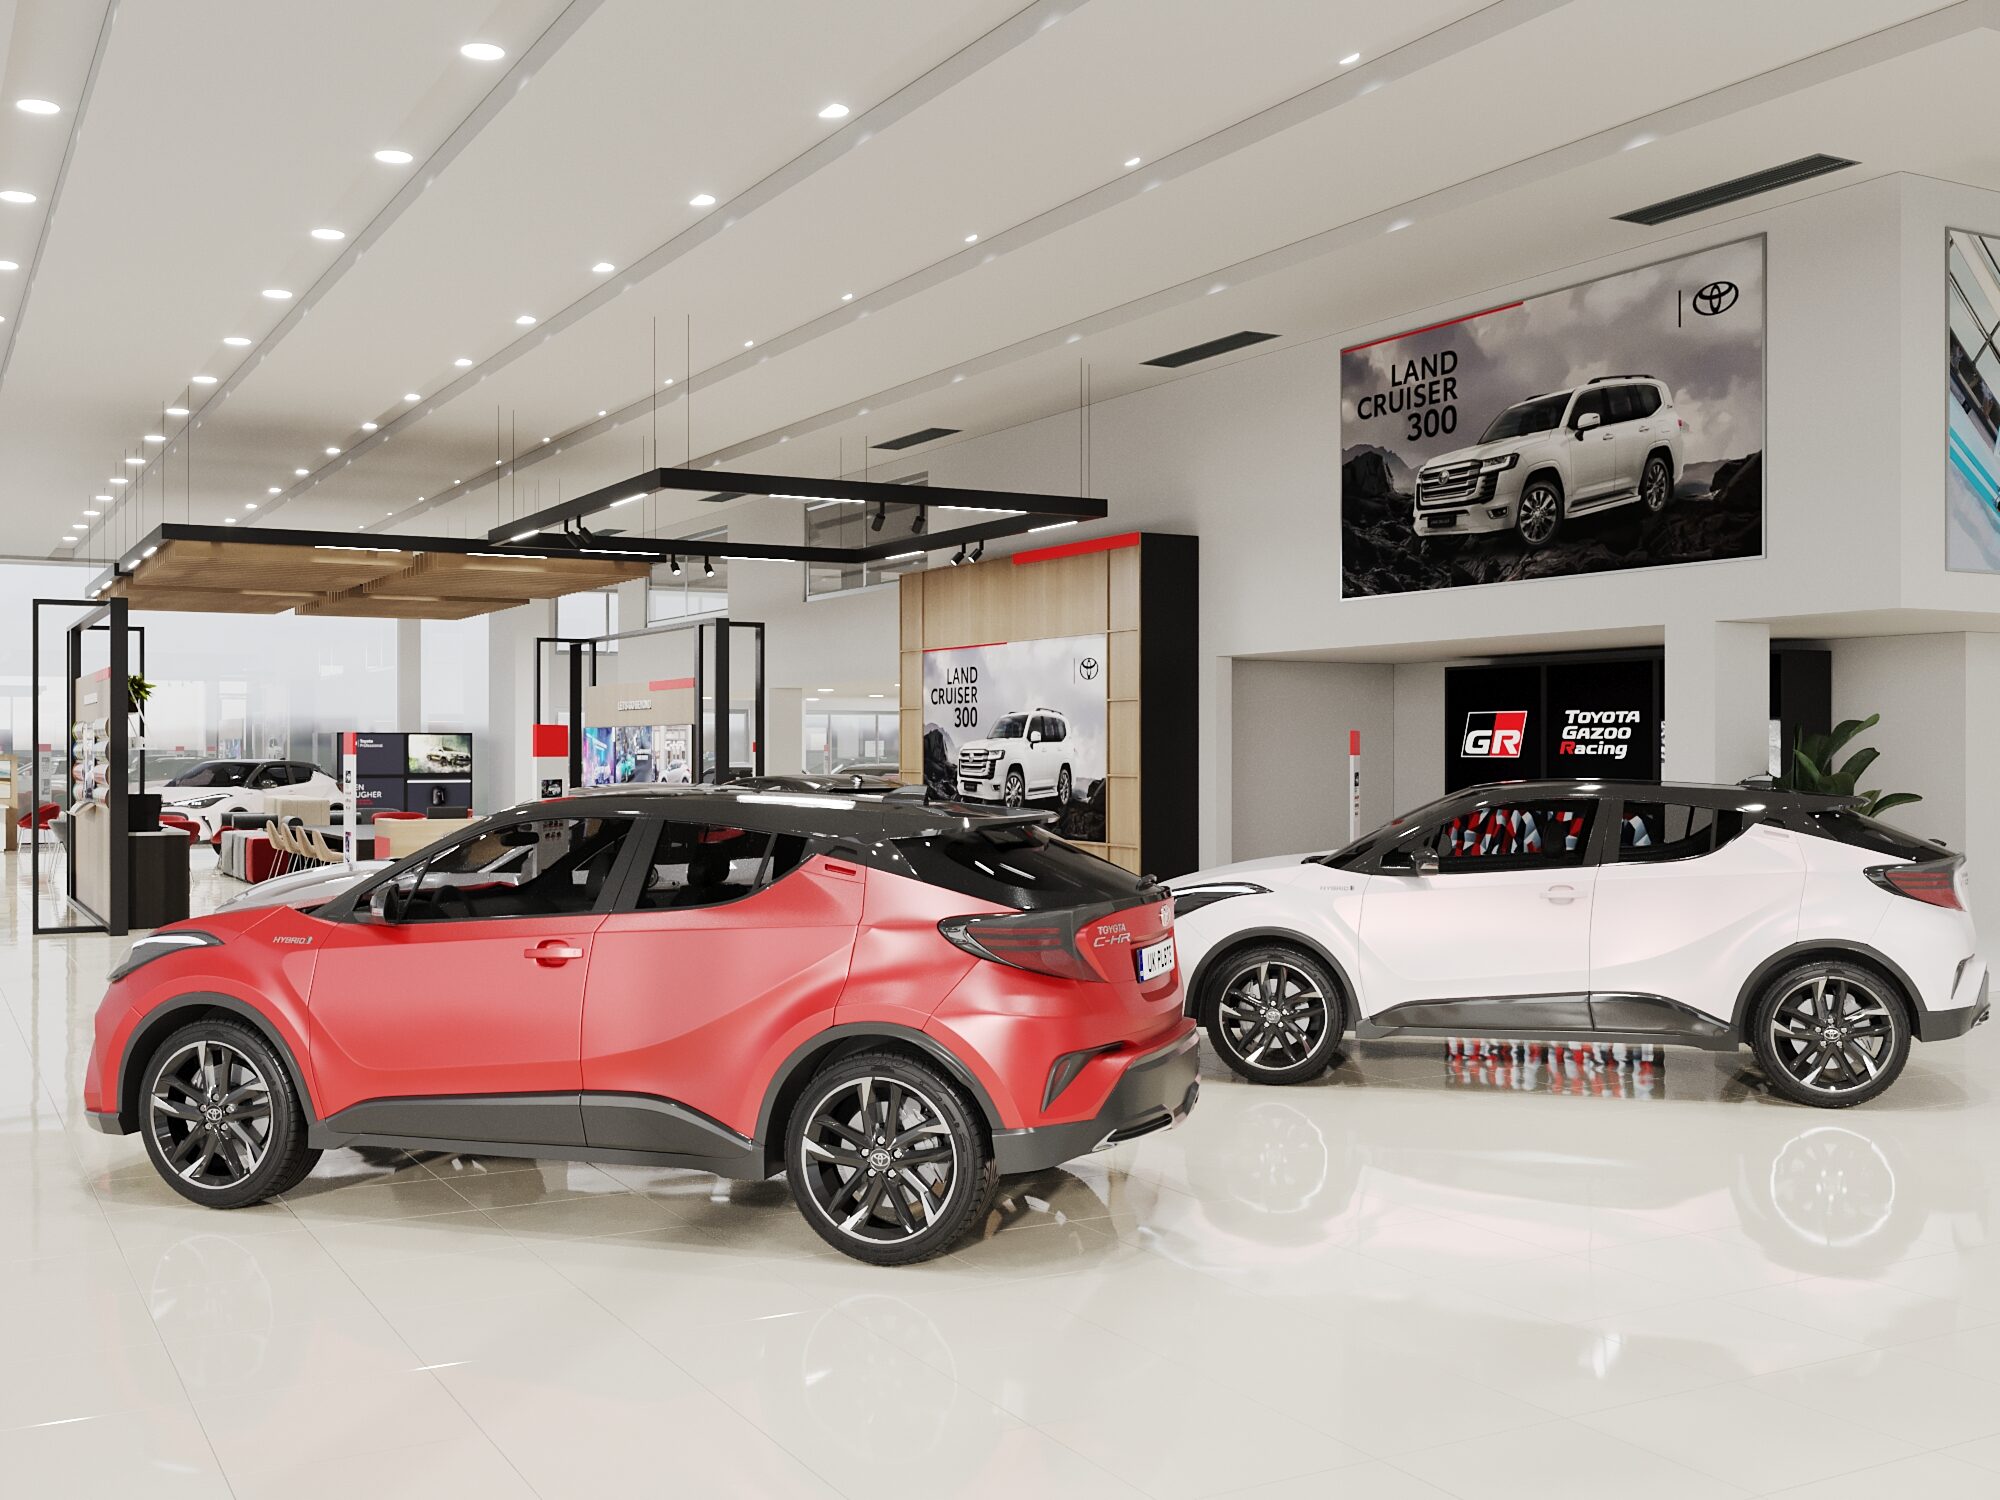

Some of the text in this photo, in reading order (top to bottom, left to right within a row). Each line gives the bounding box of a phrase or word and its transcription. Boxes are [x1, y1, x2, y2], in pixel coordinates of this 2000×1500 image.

[1391, 350, 1458, 388] LAND
[1357, 377, 1458, 420] CRUISER
[1407, 405, 1458, 442] 300
[947, 666, 978, 685] LAND
[930, 686, 978, 705] CRUISER
[954, 706, 978, 728] 300
[1565, 709, 1641, 724] TOYOTA
[1464, 729, 1521, 755] GR
[1562, 726, 1632, 740] GAZOO
[1559, 741, 1628, 760] Racing
[355, 790, 382, 799] UGHER
[1097, 923, 1127, 935] TOYOTA
[272, 936, 306, 944] HYBRID
[1093, 933, 1131, 948] C-HR
